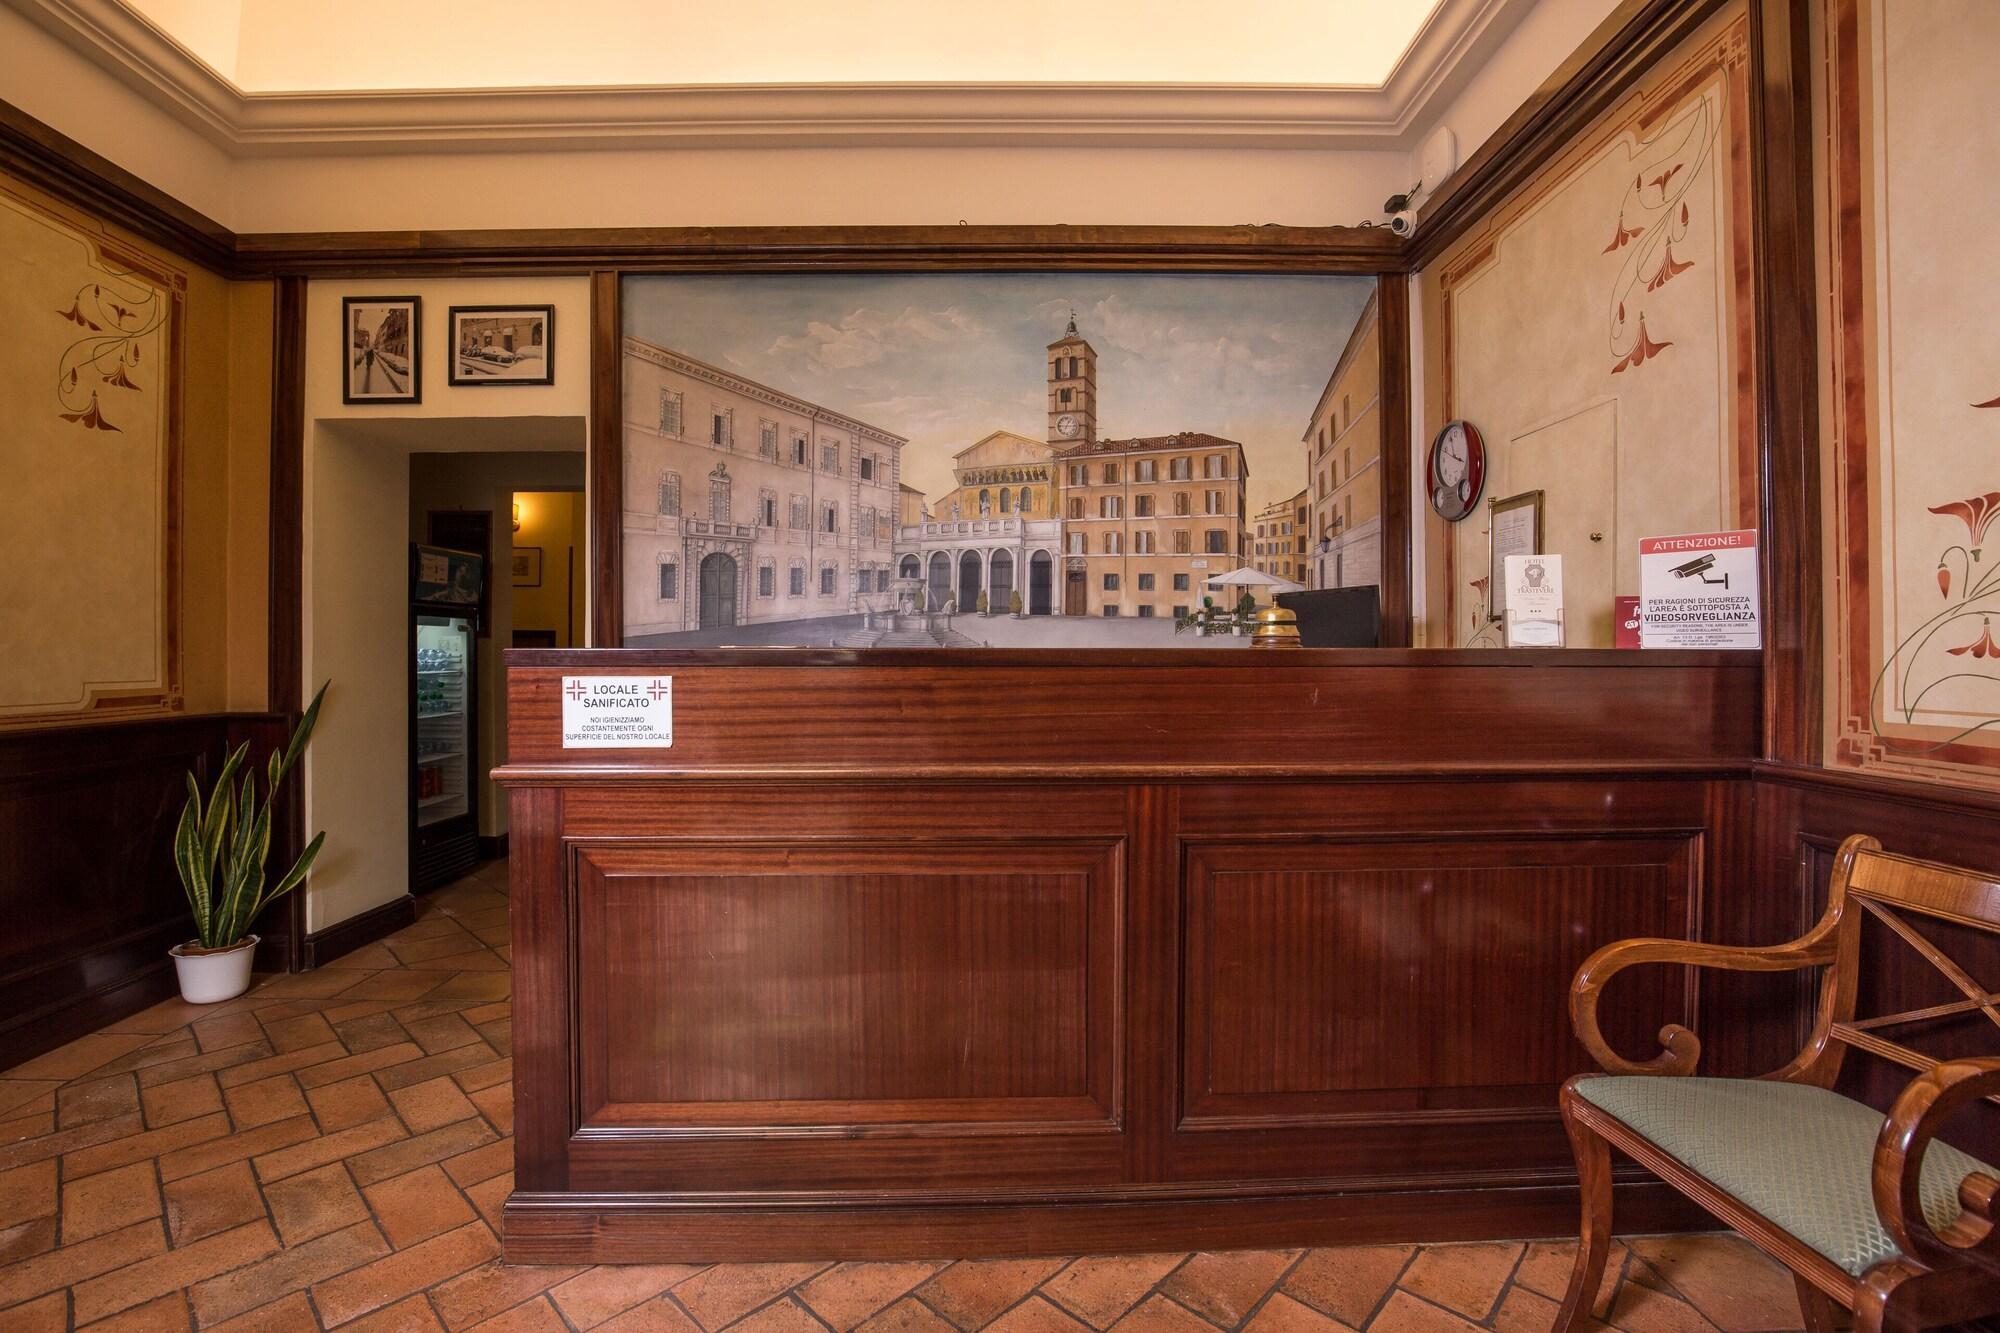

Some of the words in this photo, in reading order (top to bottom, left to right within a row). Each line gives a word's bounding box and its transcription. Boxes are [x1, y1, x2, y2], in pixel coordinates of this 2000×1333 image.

[1653, 535, 1741, 551] ATTENZIONE!
[1707, 596, 1751, 604] SICUREZZA
[1649, 605, 1678, 613] L'AREA
[1687, 604, 1741, 612] SOTTOPOSTA
[1644, 612, 1756, 622] VIDEOSORVEGLIANZA
[593, 684, 639, 695] LOCALE
[583, 698, 650, 708] SANIFICATO
